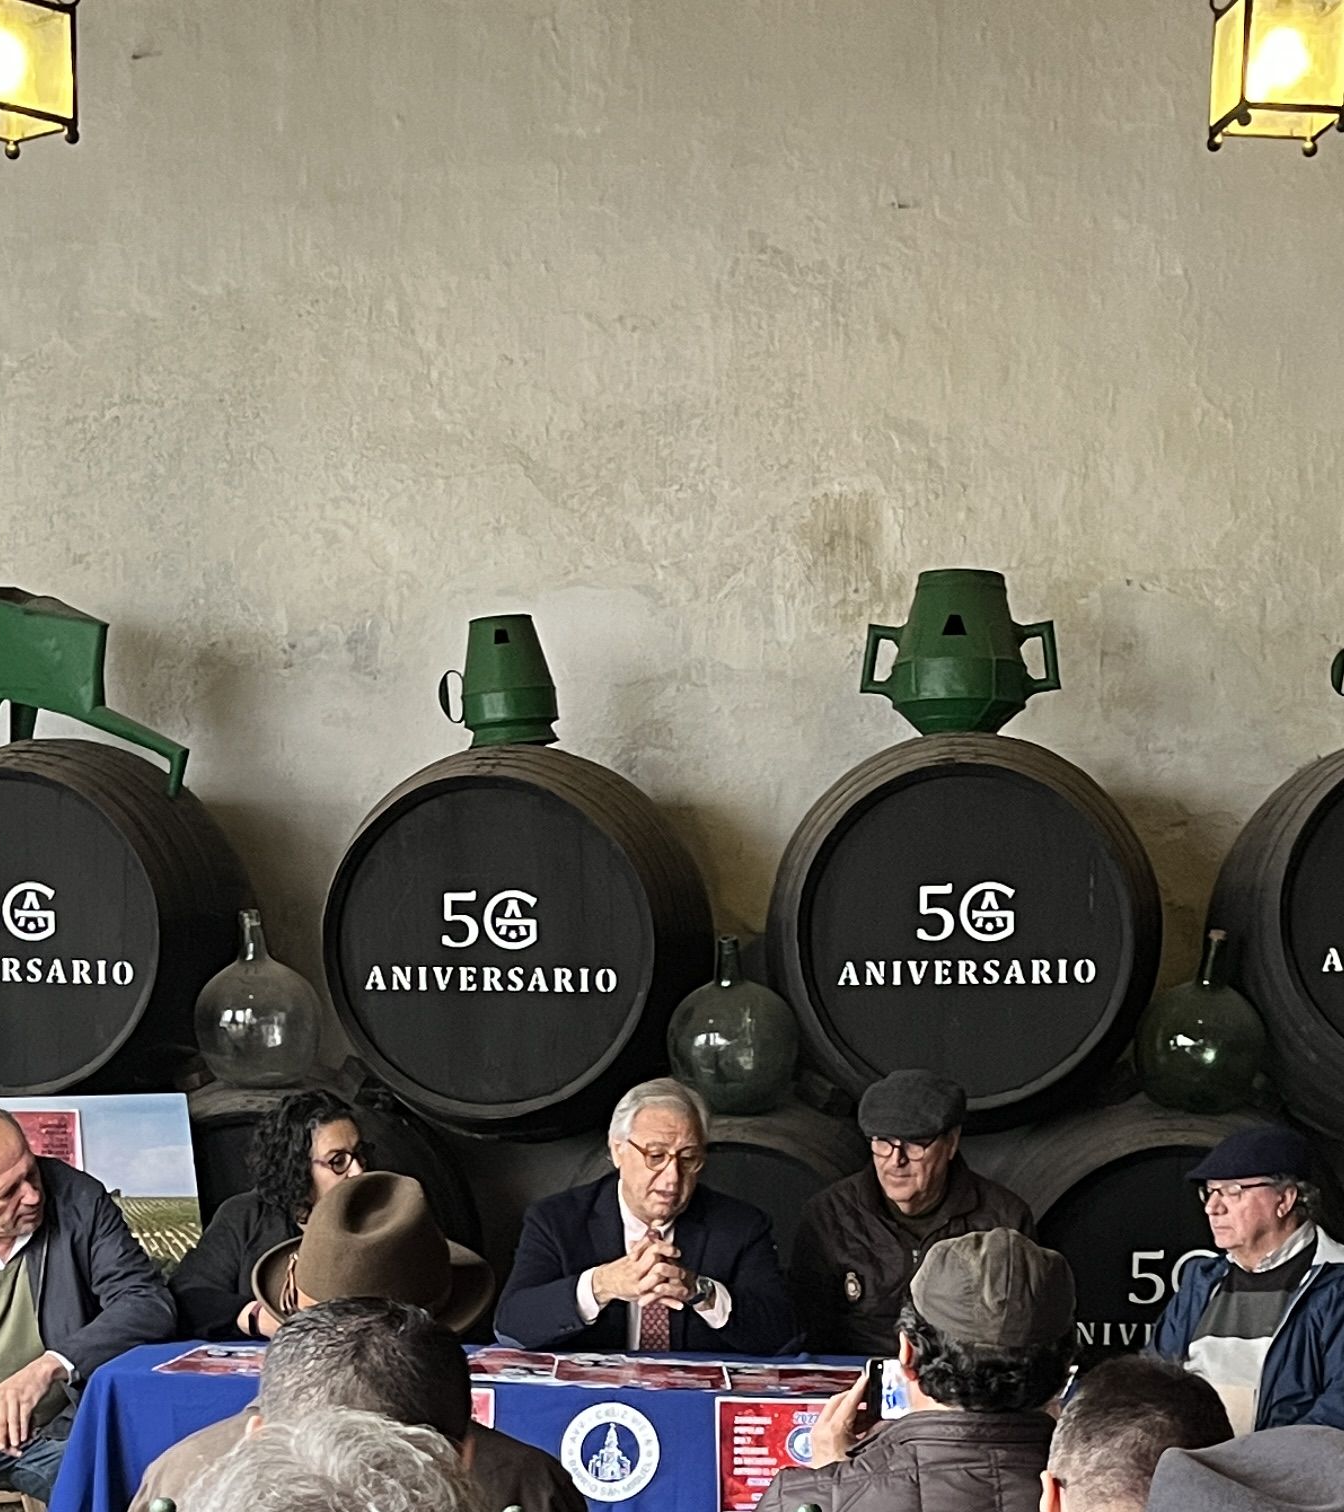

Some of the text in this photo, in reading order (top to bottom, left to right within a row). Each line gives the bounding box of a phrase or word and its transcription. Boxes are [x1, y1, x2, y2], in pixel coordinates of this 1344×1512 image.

[364, 965, 617, 993] ANIVERSARIO
[837, 958, 1096, 986] ANIVERSARIO
[600, 1486, 621, 1497] SAN
